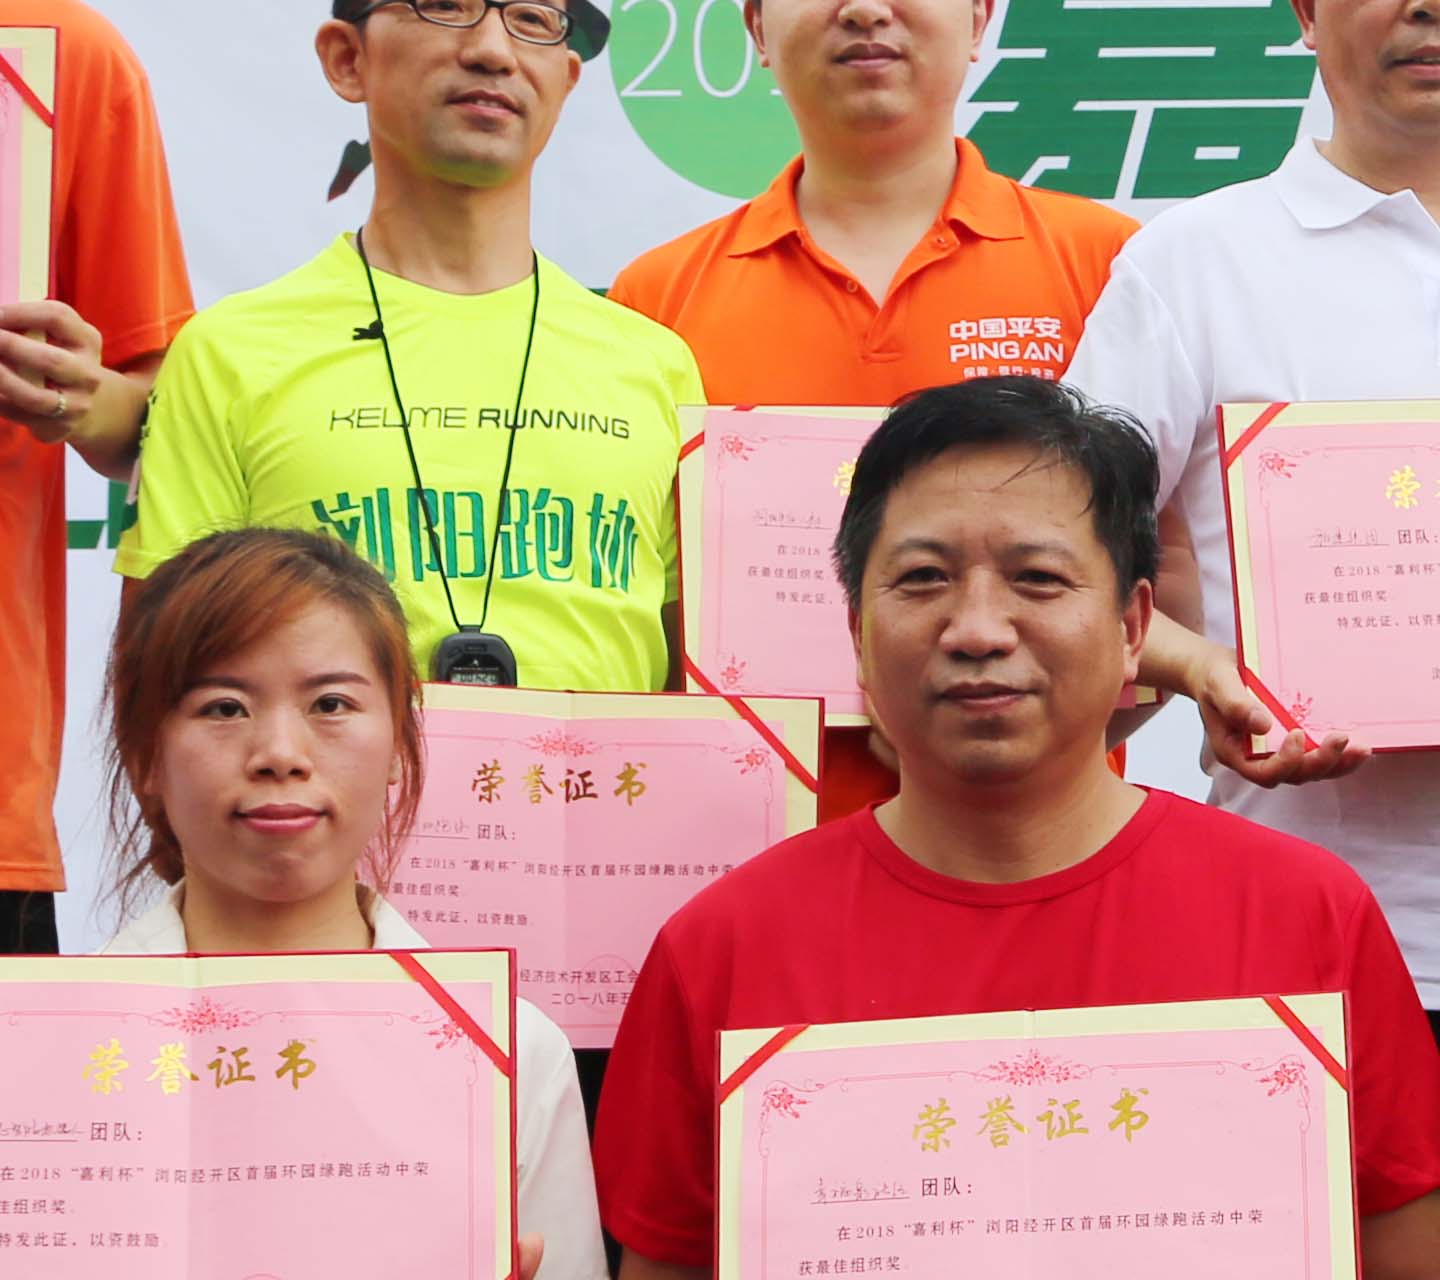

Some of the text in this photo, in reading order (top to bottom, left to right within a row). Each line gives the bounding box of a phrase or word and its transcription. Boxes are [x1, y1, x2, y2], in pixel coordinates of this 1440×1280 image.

[949, 316, 1062, 341] 中国平安
[329, 406, 632, 441] KELME RUNNING
[471, 760, 649, 806] 荣誉证书
[83, 1036, 320, 1095] 荣誉证书
[911, 1086, 1152, 1153] 荣誉证书
